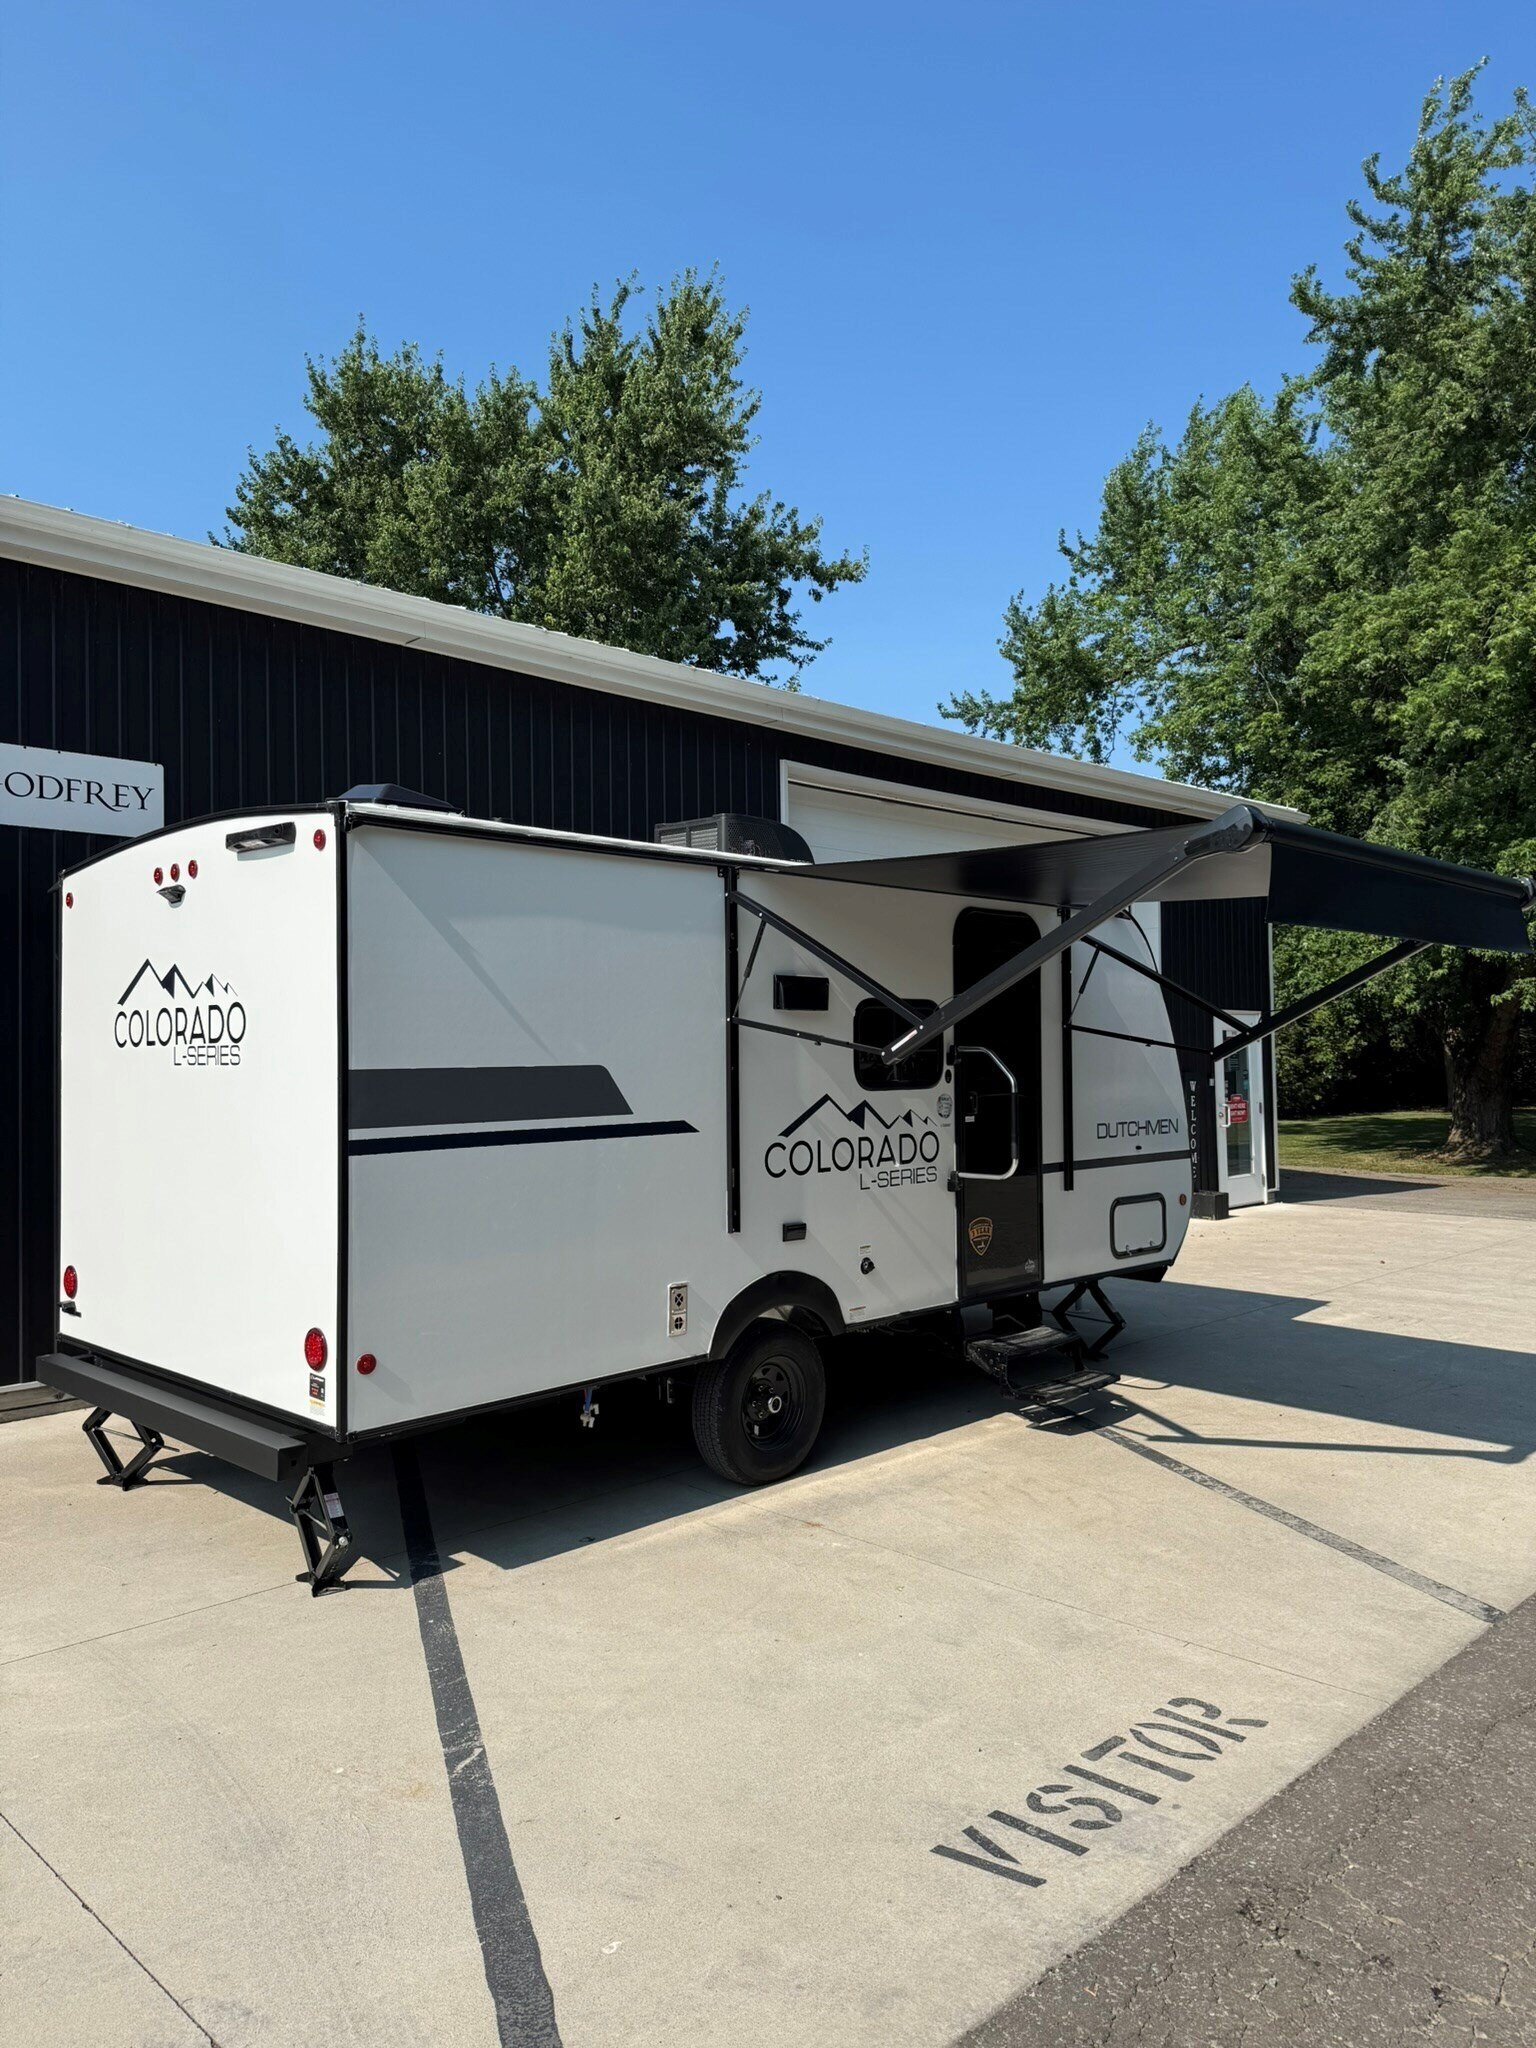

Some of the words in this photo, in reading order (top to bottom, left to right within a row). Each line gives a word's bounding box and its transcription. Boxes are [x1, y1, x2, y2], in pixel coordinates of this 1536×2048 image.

[0, 771, 155, 812] ODFREY
[114, 1001, 247, 1048] COLORADO
[173, 1045, 241, 1066] L-SERIES
[1097, 1118, 1179, 1139] DUTCHMEN
[764, 1130, 940, 1178] COLORADO
[860, 1166, 938, 1190] L-SERIES
[930, 1697, 1269, 1888] VISITOR
